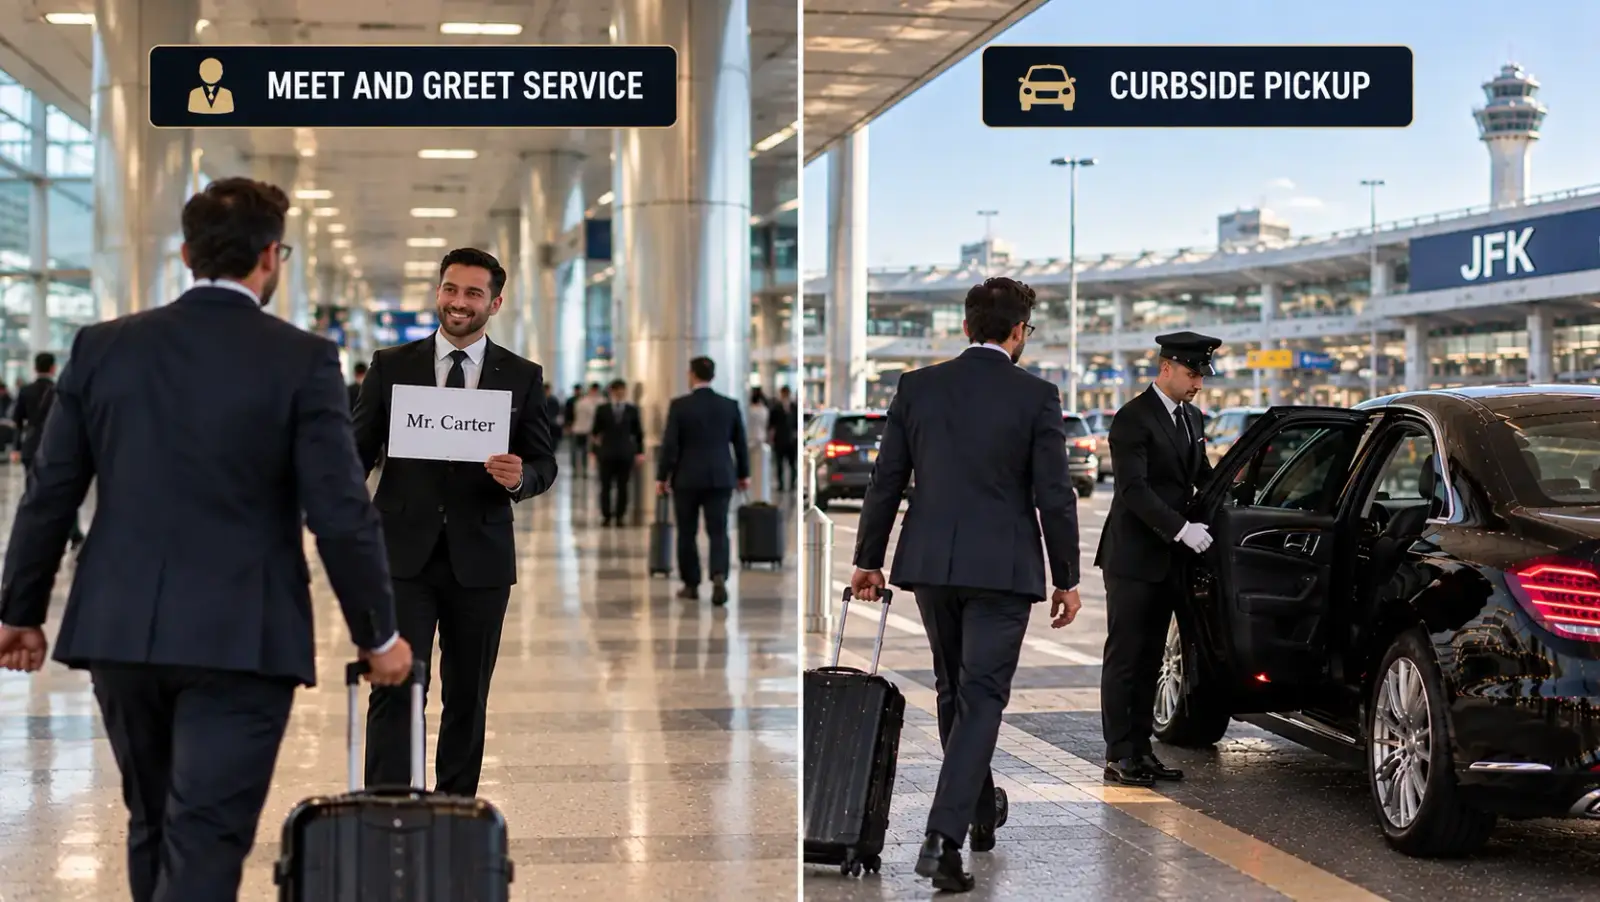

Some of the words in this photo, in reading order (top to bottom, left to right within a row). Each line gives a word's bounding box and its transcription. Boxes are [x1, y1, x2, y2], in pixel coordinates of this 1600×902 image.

[1460, 226, 1536, 281] JFK
[406, 413, 435, 429] Mr.
[440, 414, 496, 433] Carter
